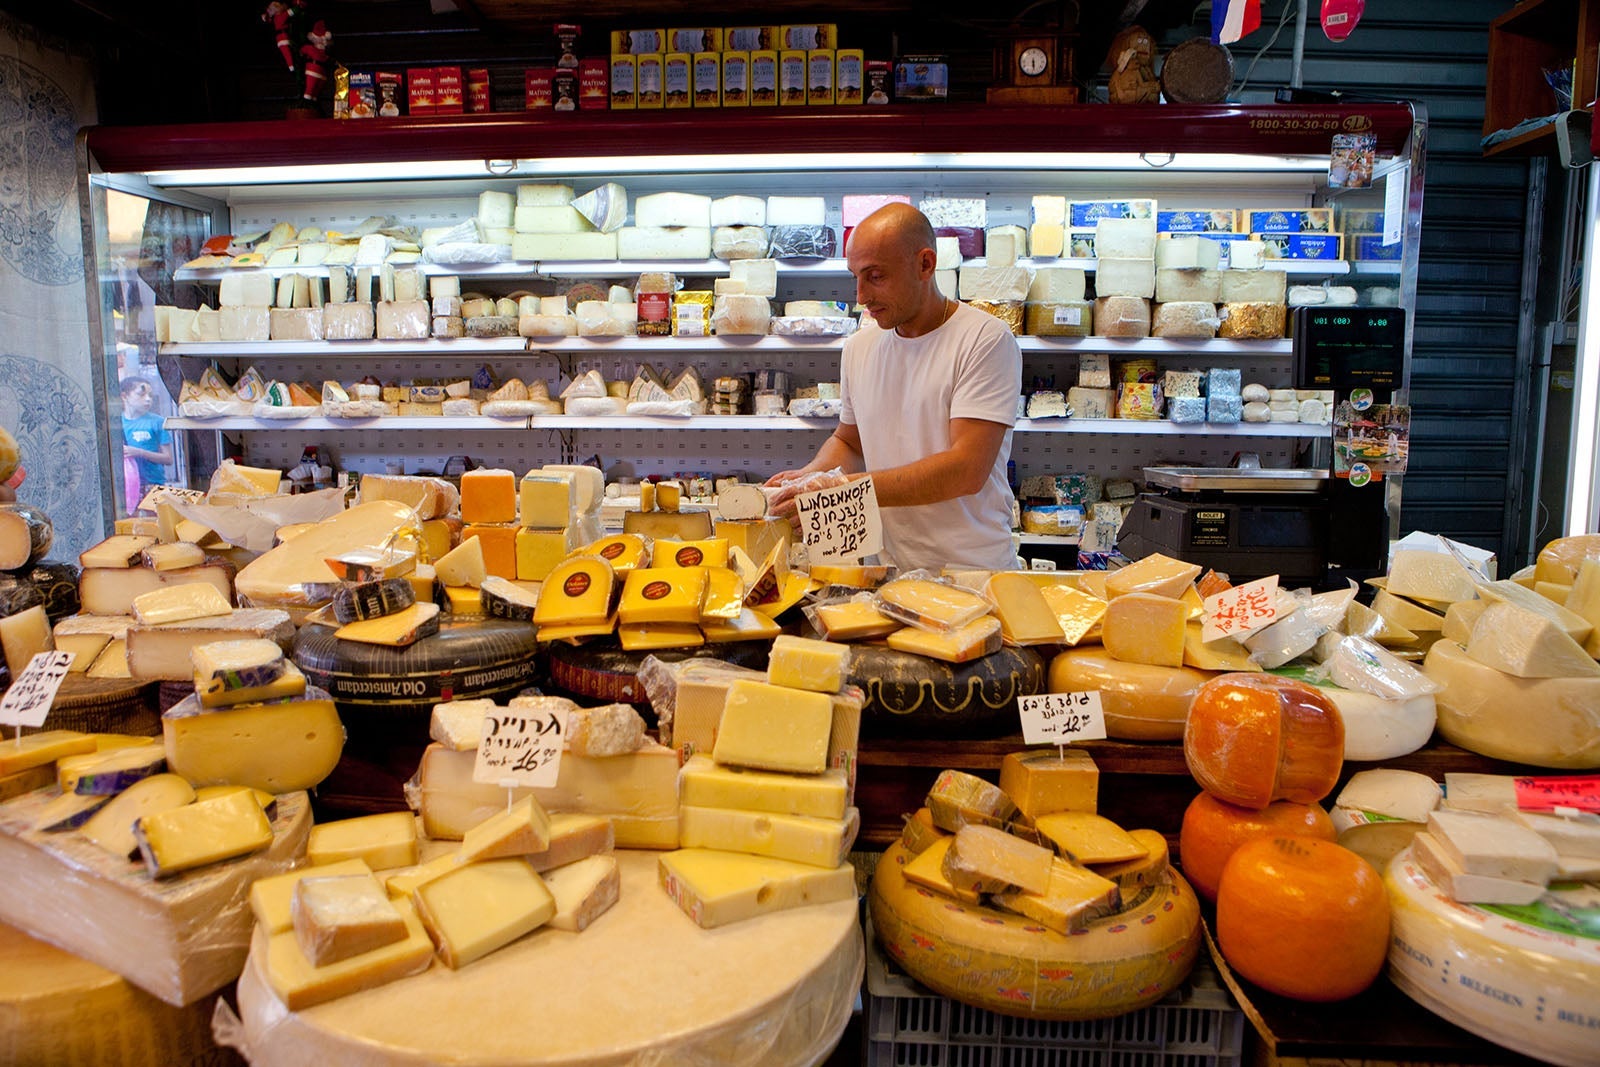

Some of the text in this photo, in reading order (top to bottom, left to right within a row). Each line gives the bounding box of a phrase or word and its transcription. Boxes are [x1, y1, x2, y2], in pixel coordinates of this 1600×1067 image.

[582, 79, 606, 87] MATTINO
[438, 87, 461, 95] MATTINO
[1249, 119, 1338, 130] 1800-30-30-60
[1368, 318, 1388, 326] 0.00
[799, 479, 871, 513] LINDENHOFF
[464, 660, 536, 687] Old Amsterdam
[336, 679, 426, 696] Old Amsterdam
[1459, 974, 1524, 1008] BELEGEN
